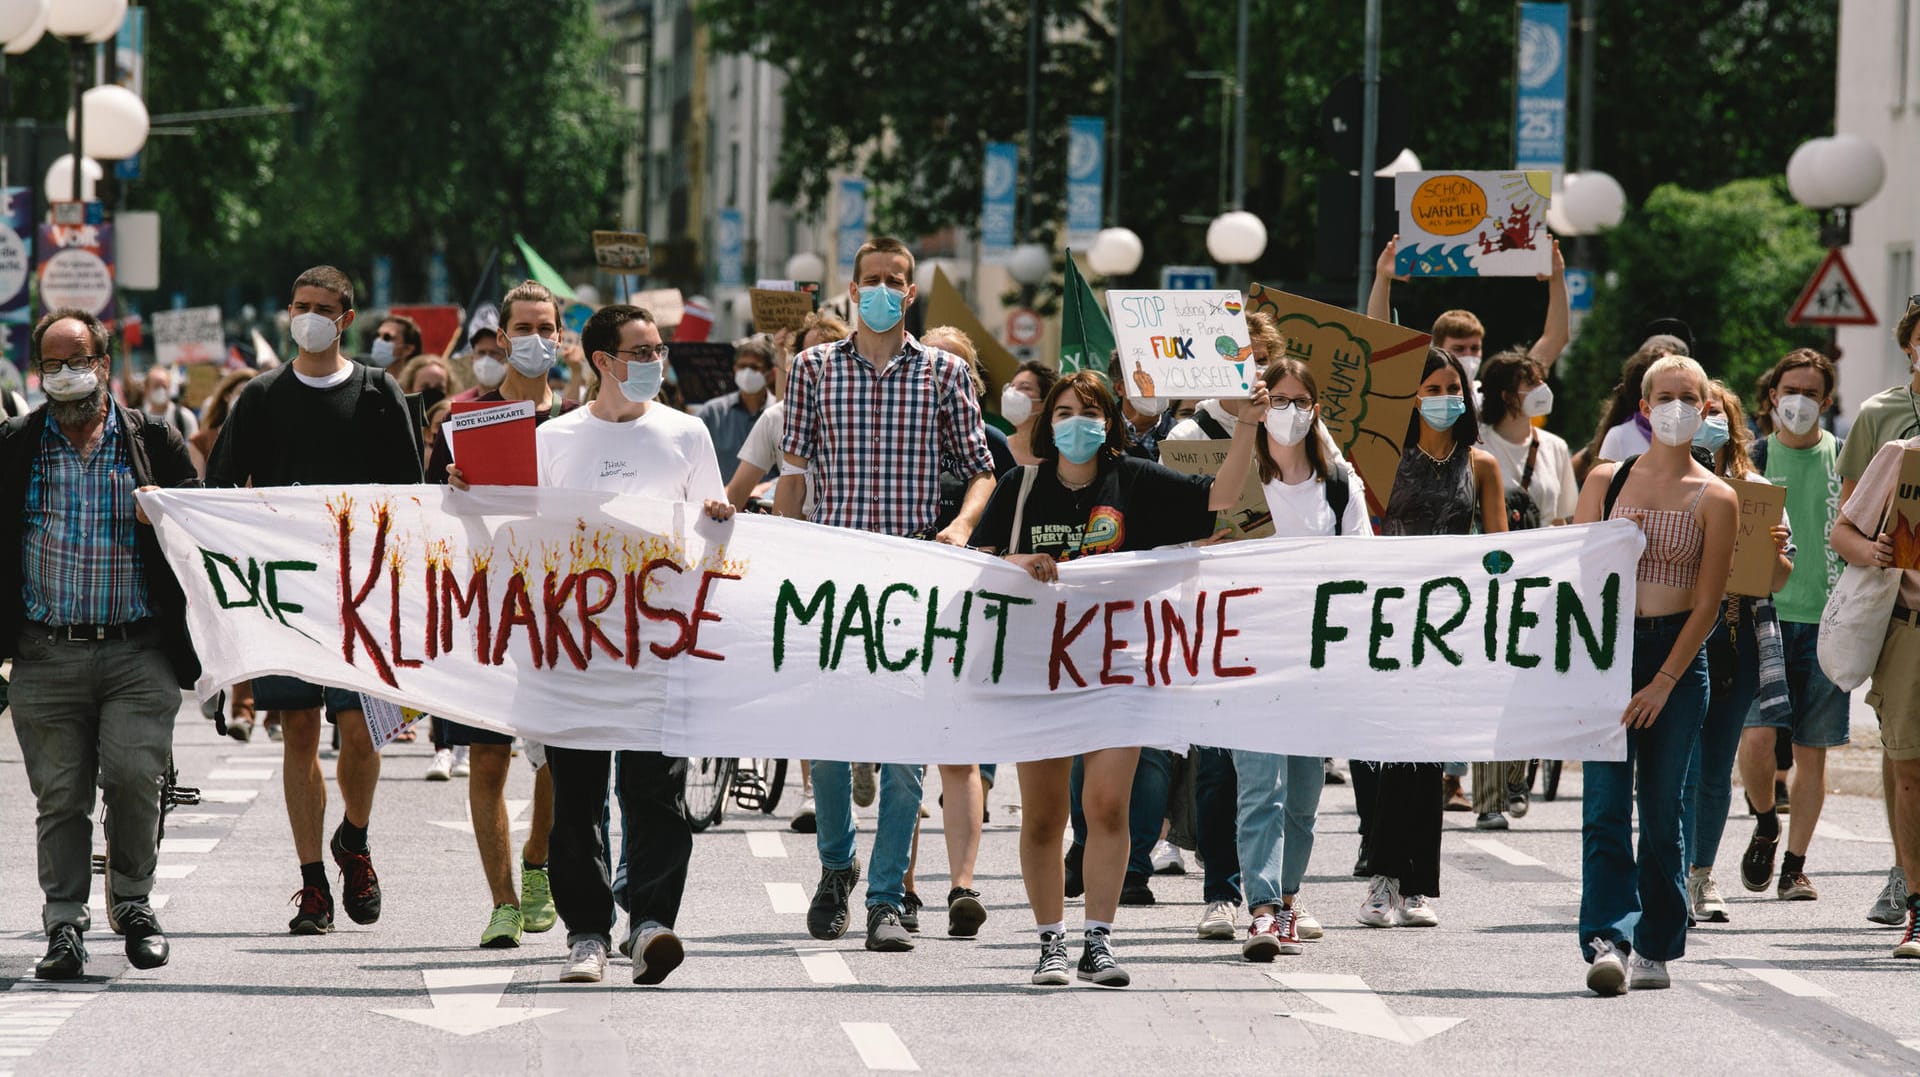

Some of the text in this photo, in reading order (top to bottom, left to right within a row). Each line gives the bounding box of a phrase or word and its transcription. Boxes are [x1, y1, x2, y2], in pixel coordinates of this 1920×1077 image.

[1519, 113, 1552, 138] 25
[1121, 296, 1165, 328] STOP
[1150, 336, 1195, 360] FUCK
[456, 418, 475, 427] ROTE
[477, 408, 525, 424] KLIMAKARTE
[1171, 453, 1198, 464] WHAT
[1213, 452, 1228, 464] STA
[1031, 526, 1042, 535] BE
[1044, 524, 1072, 533] KIND
[1032, 533, 1064, 544] EVERY
[198, 546, 320, 644] DIE
[338, 513, 742, 689] KLIMAKRISE
[773, 578, 1035, 684] MACHT
[1049, 587, 1262, 691] KEINE
